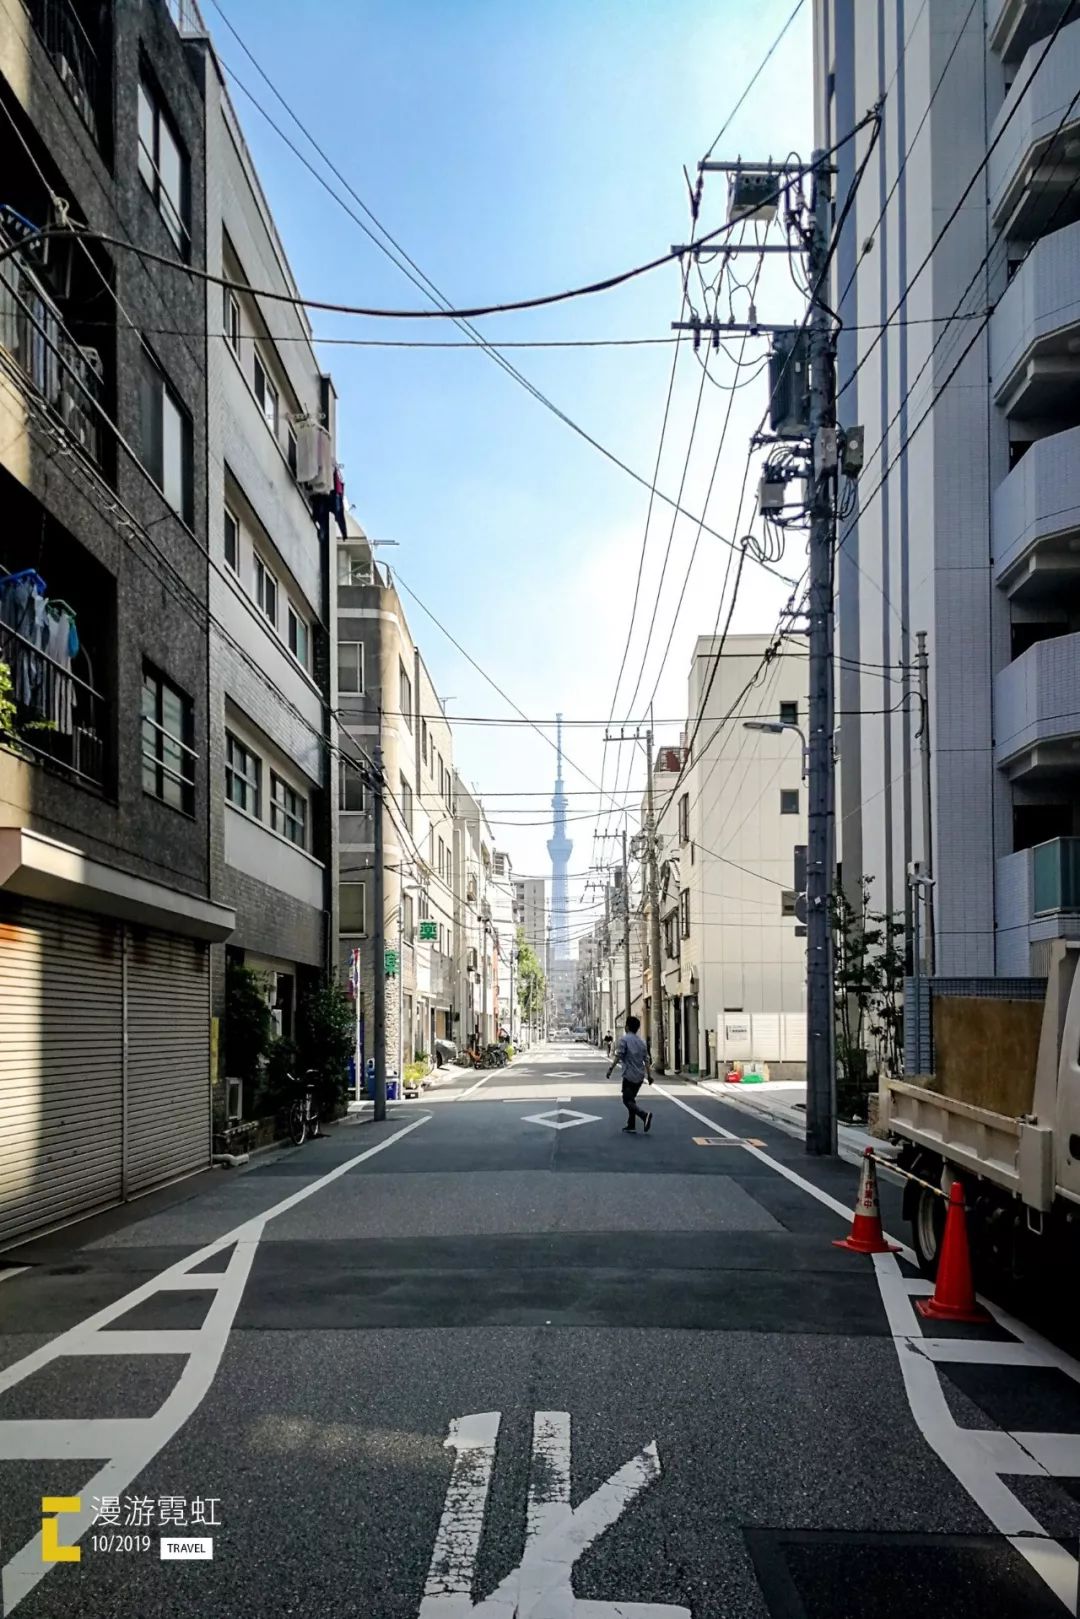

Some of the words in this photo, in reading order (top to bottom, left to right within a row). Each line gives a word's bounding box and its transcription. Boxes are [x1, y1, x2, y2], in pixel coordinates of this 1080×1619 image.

[419, 921, 437, 940] 薬
[864, 1180, 873, 1208] 作業中
